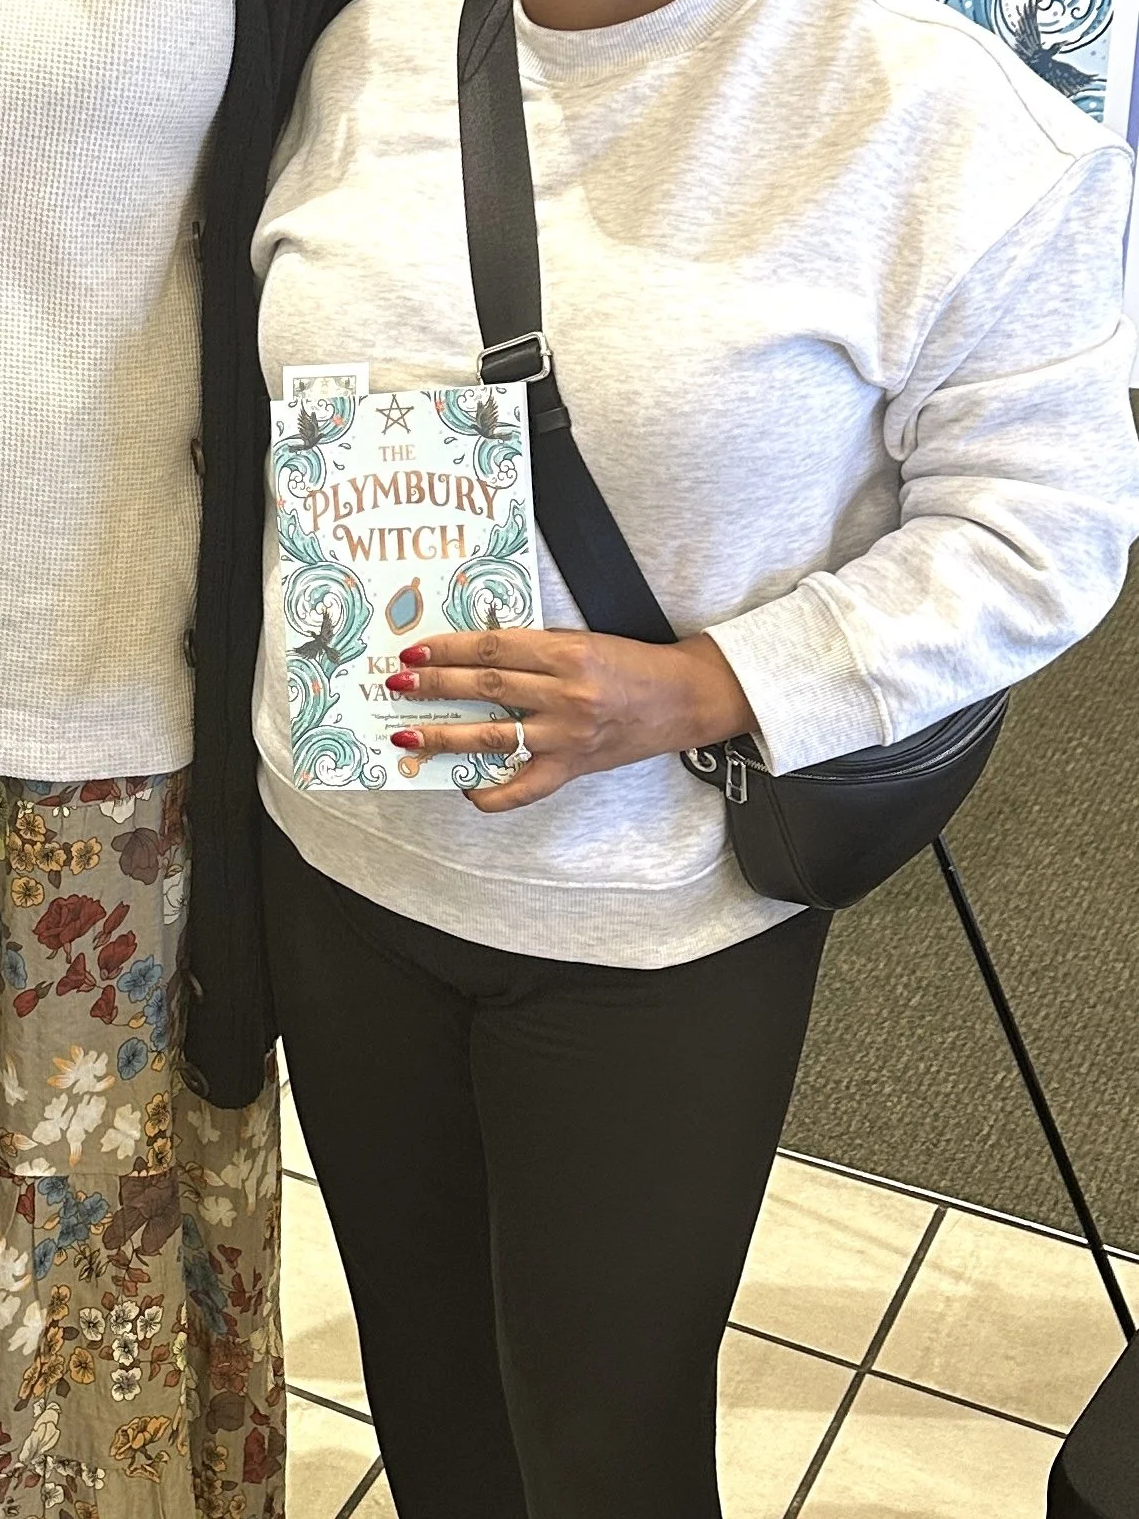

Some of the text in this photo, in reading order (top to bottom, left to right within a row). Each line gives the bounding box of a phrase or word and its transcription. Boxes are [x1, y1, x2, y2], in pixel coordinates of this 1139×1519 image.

[378, 444, 417, 463] THE
[303, 470, 502, 535] PLYMBURY
[332, 524, 467, 562] WITCH
